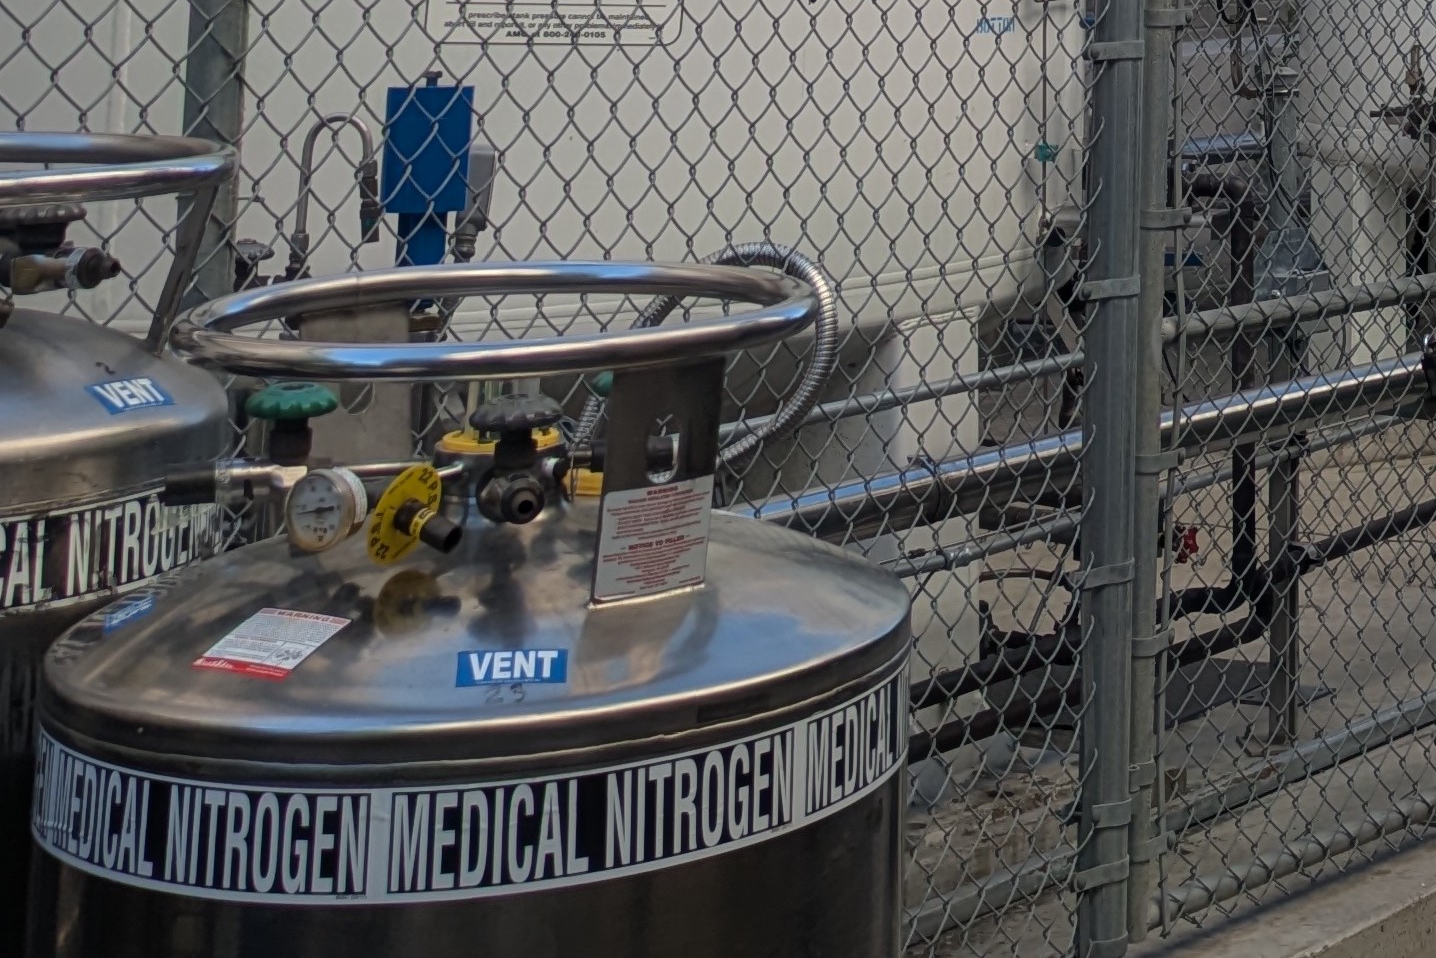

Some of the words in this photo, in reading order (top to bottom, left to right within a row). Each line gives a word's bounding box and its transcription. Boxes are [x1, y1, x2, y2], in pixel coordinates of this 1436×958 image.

[93, 378, 165, 408] VENT
[277, 610, 331, 622] WARNING
[469, 650, 558, 681] VENT
[56, 750, 154, 877] MEDICAL
[165, 784, 368, 894] NITROGEN
[390, 778, 589, 893] MEDICAL
[606, 731, 793, 868] NITROGEN
[807, 683, 893, 814] MEDICAL
